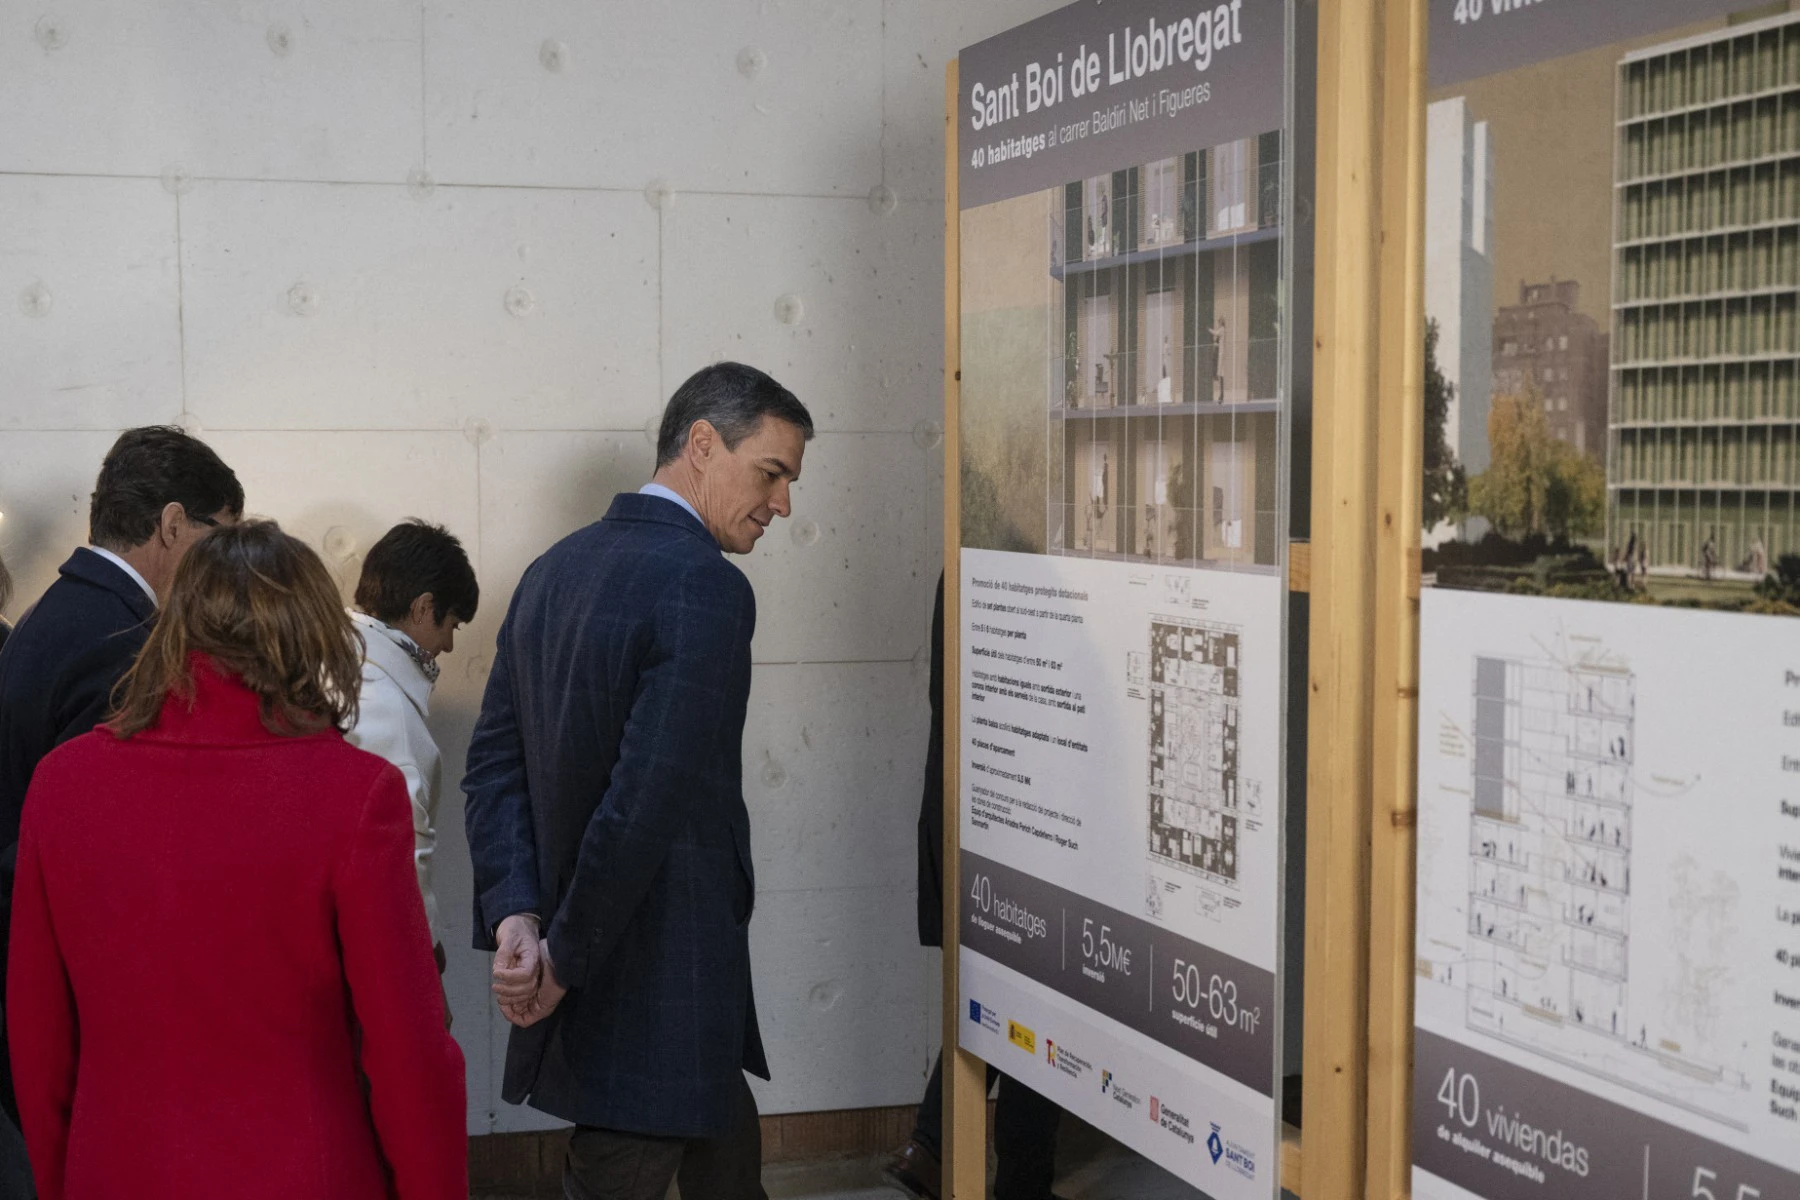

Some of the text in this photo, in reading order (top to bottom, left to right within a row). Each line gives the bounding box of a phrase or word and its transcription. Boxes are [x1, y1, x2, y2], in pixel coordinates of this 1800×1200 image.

[971, 0, 1242, 131] Sant Boi de Llobregat
[971, 82, 1211, 169] 40 habitatges al carrer Baldiri Net i Figueres
[971, 872, 1046, 938] 40 habitatges
[1160, 1103, 1190, 1128] Generalitat
[1160, 1117, 1195, 1145] de Catalunya
[1437, 1067, 1589, 1177] 40 viviendas
[1437, 1124, 1545, 1185] de alquiler asequible
